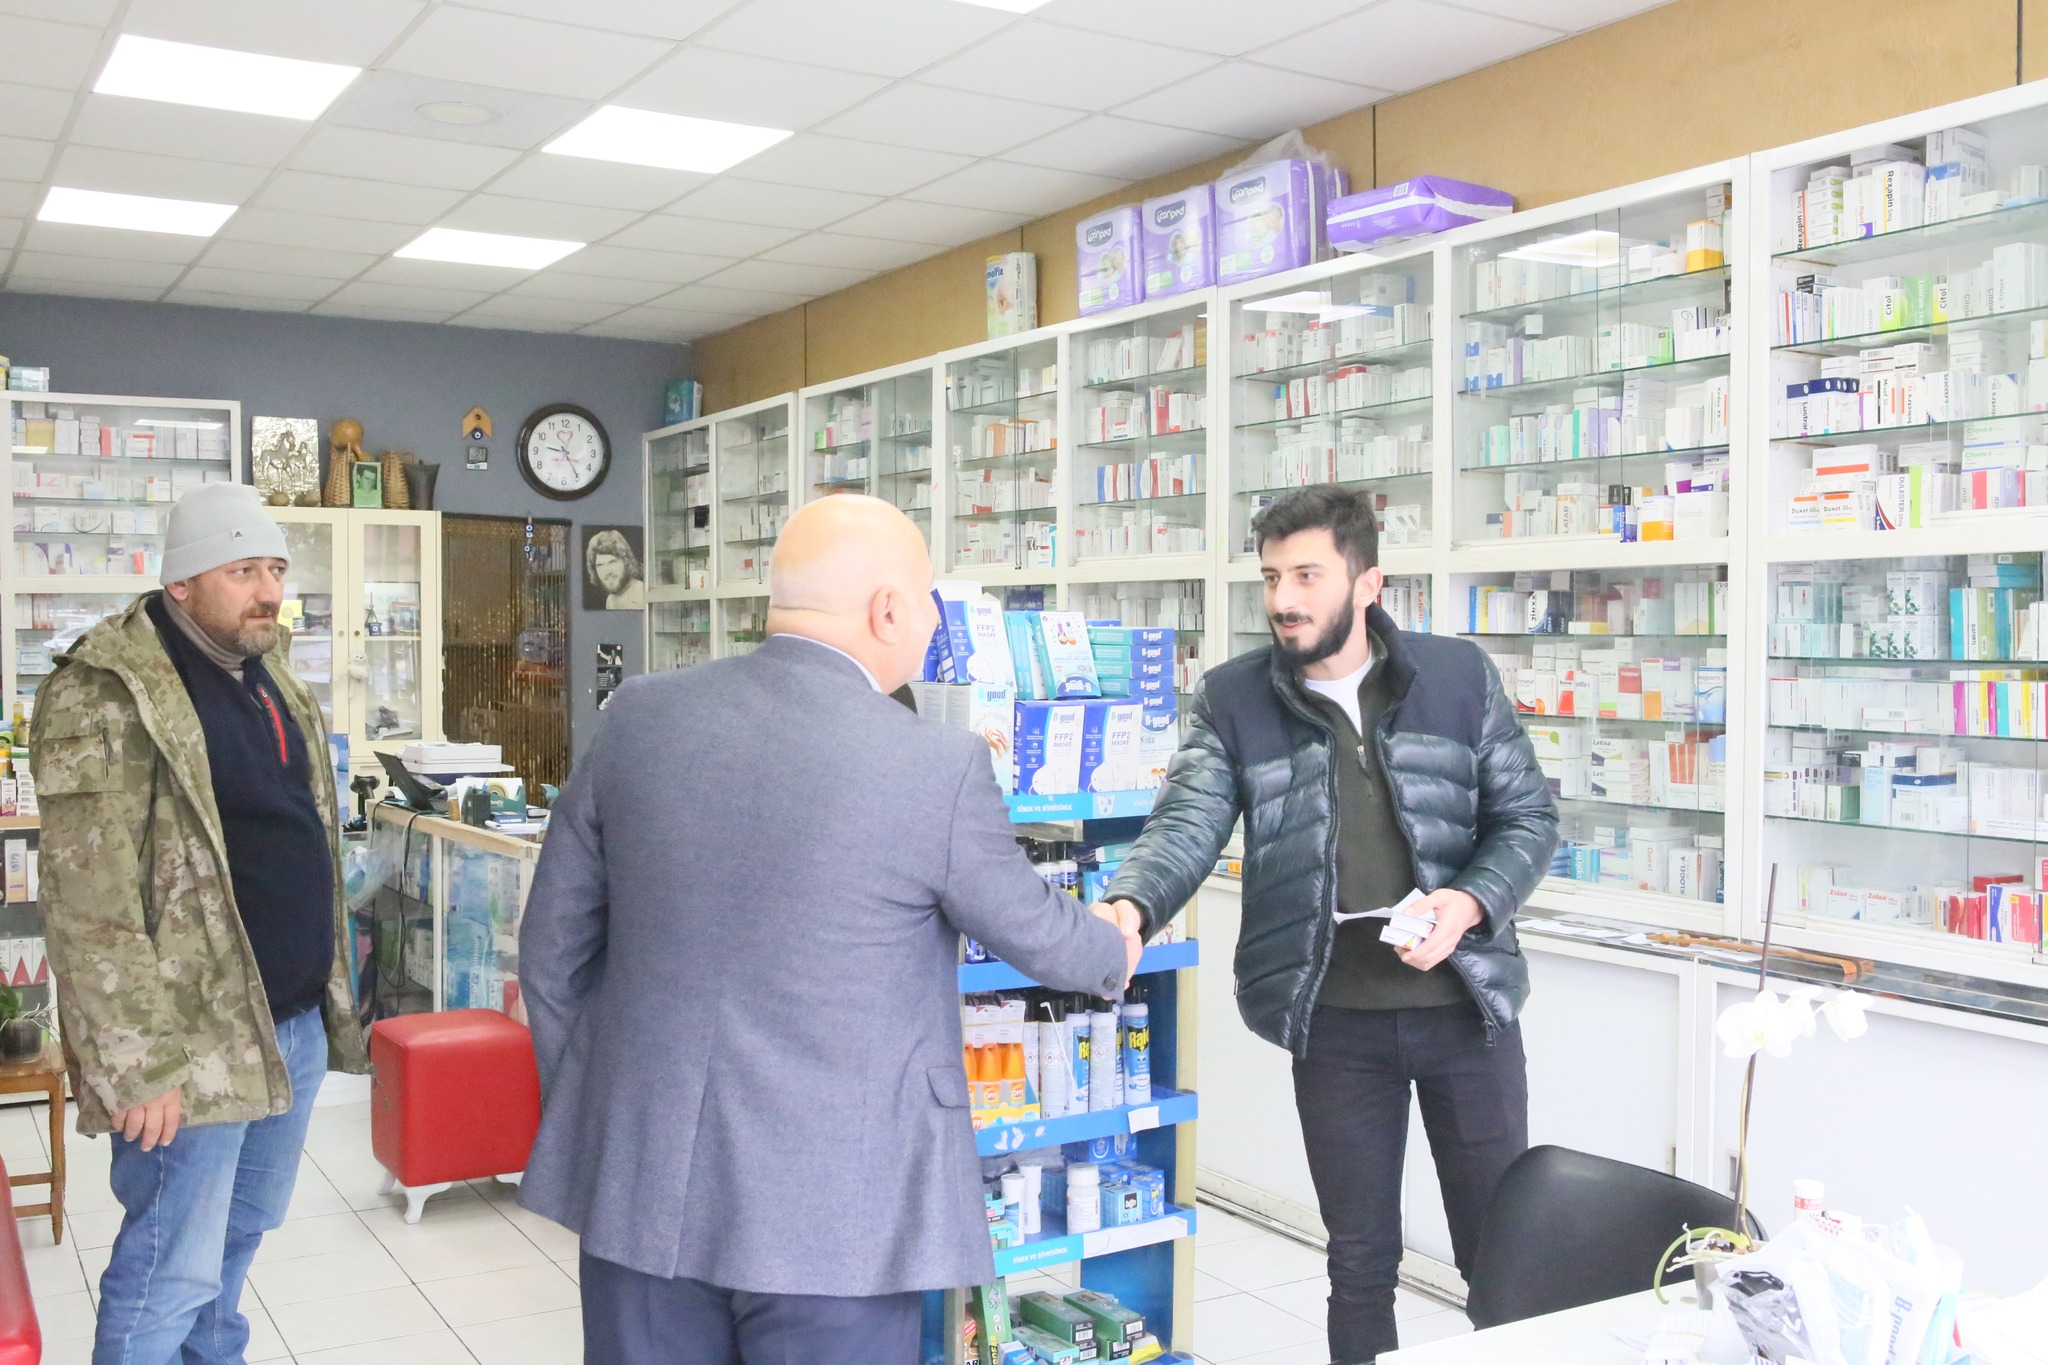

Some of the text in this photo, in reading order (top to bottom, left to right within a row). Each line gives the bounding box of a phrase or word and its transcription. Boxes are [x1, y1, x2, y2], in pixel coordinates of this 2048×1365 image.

[1232, 182, 1265, 201] canped
[1886, 170, 1894, 208] Rexapin
[1156, 205, 1185, 223] canped
[1088, 227, 1112, 242] canped
[1796, 215, 1804, 250] Rexapin
[548, 422, 555, 430] 11
[561, 419, 570, 428] 12
[577, 423, 581, 432] 1
[1966, 426, 1993, 434] Clonex
[538, 432, 546, 441] 10
[586, 435, 593, 444] 2
[533, 446, 539, 455] 9
[590, 449, 597, 458] 3
[1965, 450, 1992, 458] Clonex
[536, 460, 543, 469] 8
[586, 463, 592, 472] 4
[547, 472, 552, 481] 7
[575, 474, 581, 482] 5
[561, 477, 567, 486] 6
[1143, 632, 1162, 641] B-good
[1142, 648, 1161, 658] B-good
[1143, 664, 1162, 674] B-good
[1066, 680, 1091, 692] B-good
[1141, 681, 1160, 690] B-good
[979, 689, 1006, 701] B-good
[1144, 697, 1163, 706] B-good
[1054, 713, 1075, 723] B-good
[1111, 712, 1132, 722] B-good
[1145, 714, 1170, 728] B-good
[1054, 733, 1073, 741] FFP2
[1140, 736, 1155, 744] Kids
[1829, 889, 1848, 898] Zolax
[1867, 892, 1886, 901] Zolax
[984, 1092, 998, 1100] OFF!
[1011, 1089, 1024, 1097] OFF!
[972, 1118, 984, 1128] FF!
